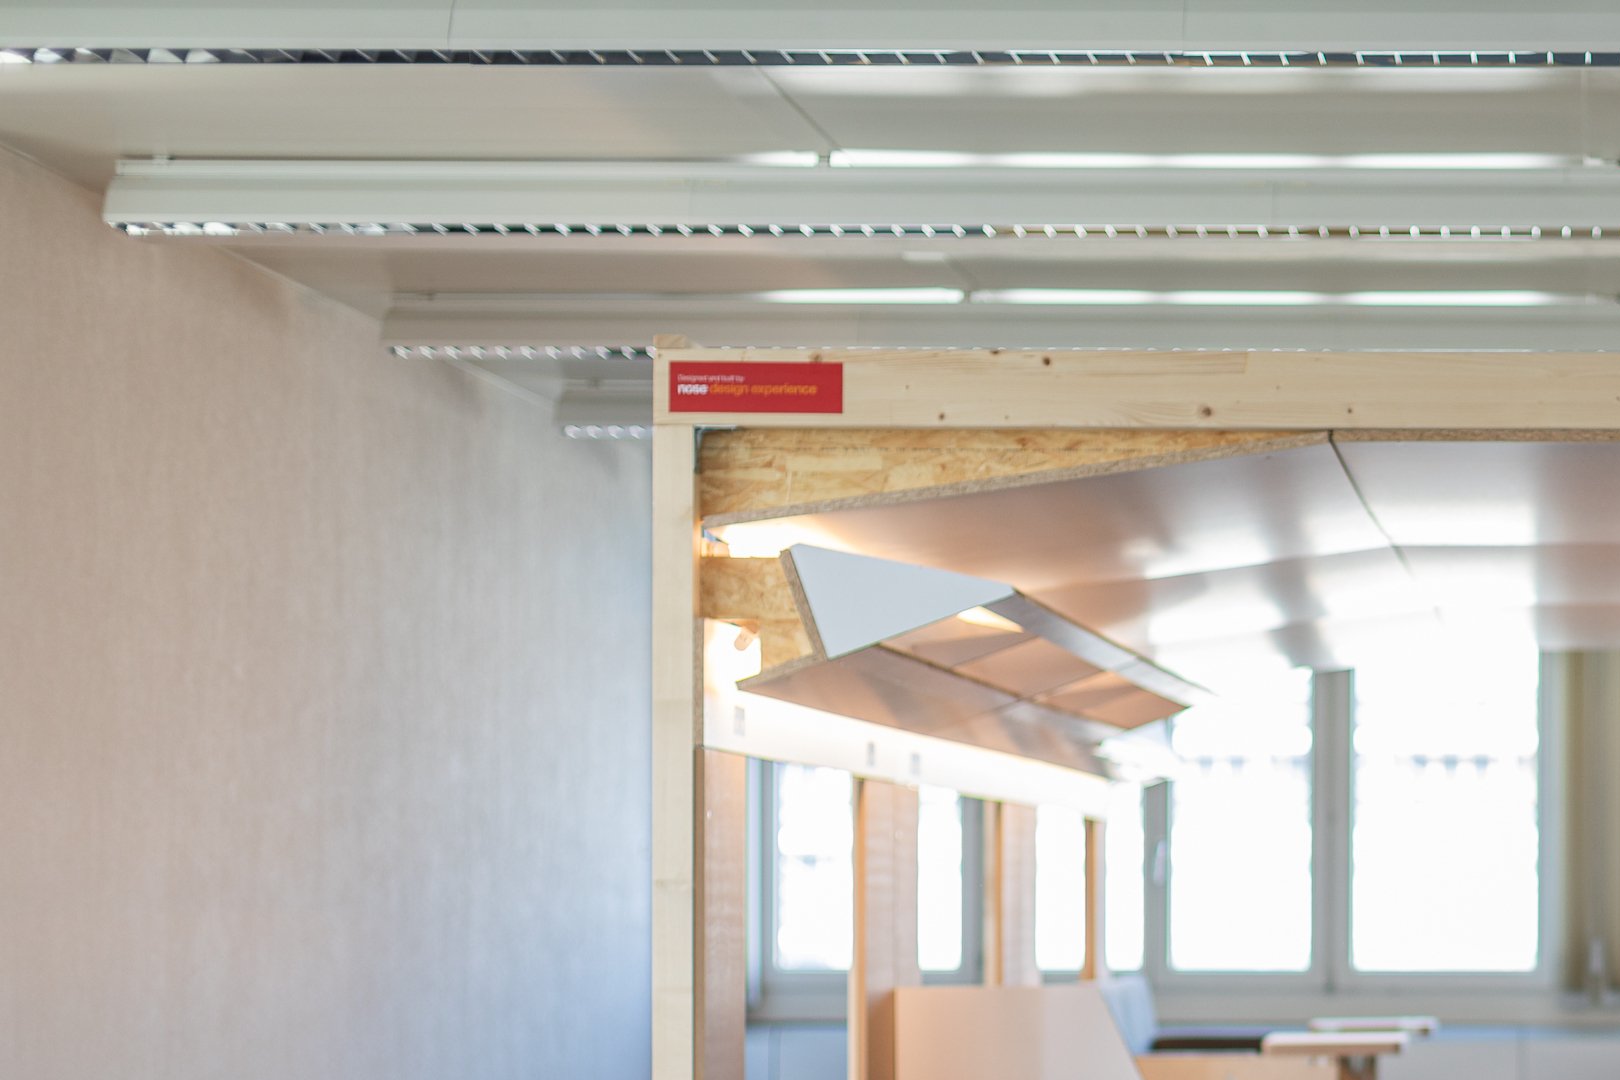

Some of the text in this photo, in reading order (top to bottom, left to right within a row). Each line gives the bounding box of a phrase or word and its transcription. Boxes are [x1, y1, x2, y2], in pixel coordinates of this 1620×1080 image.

[677, 382, 817, 397] nose design experience
